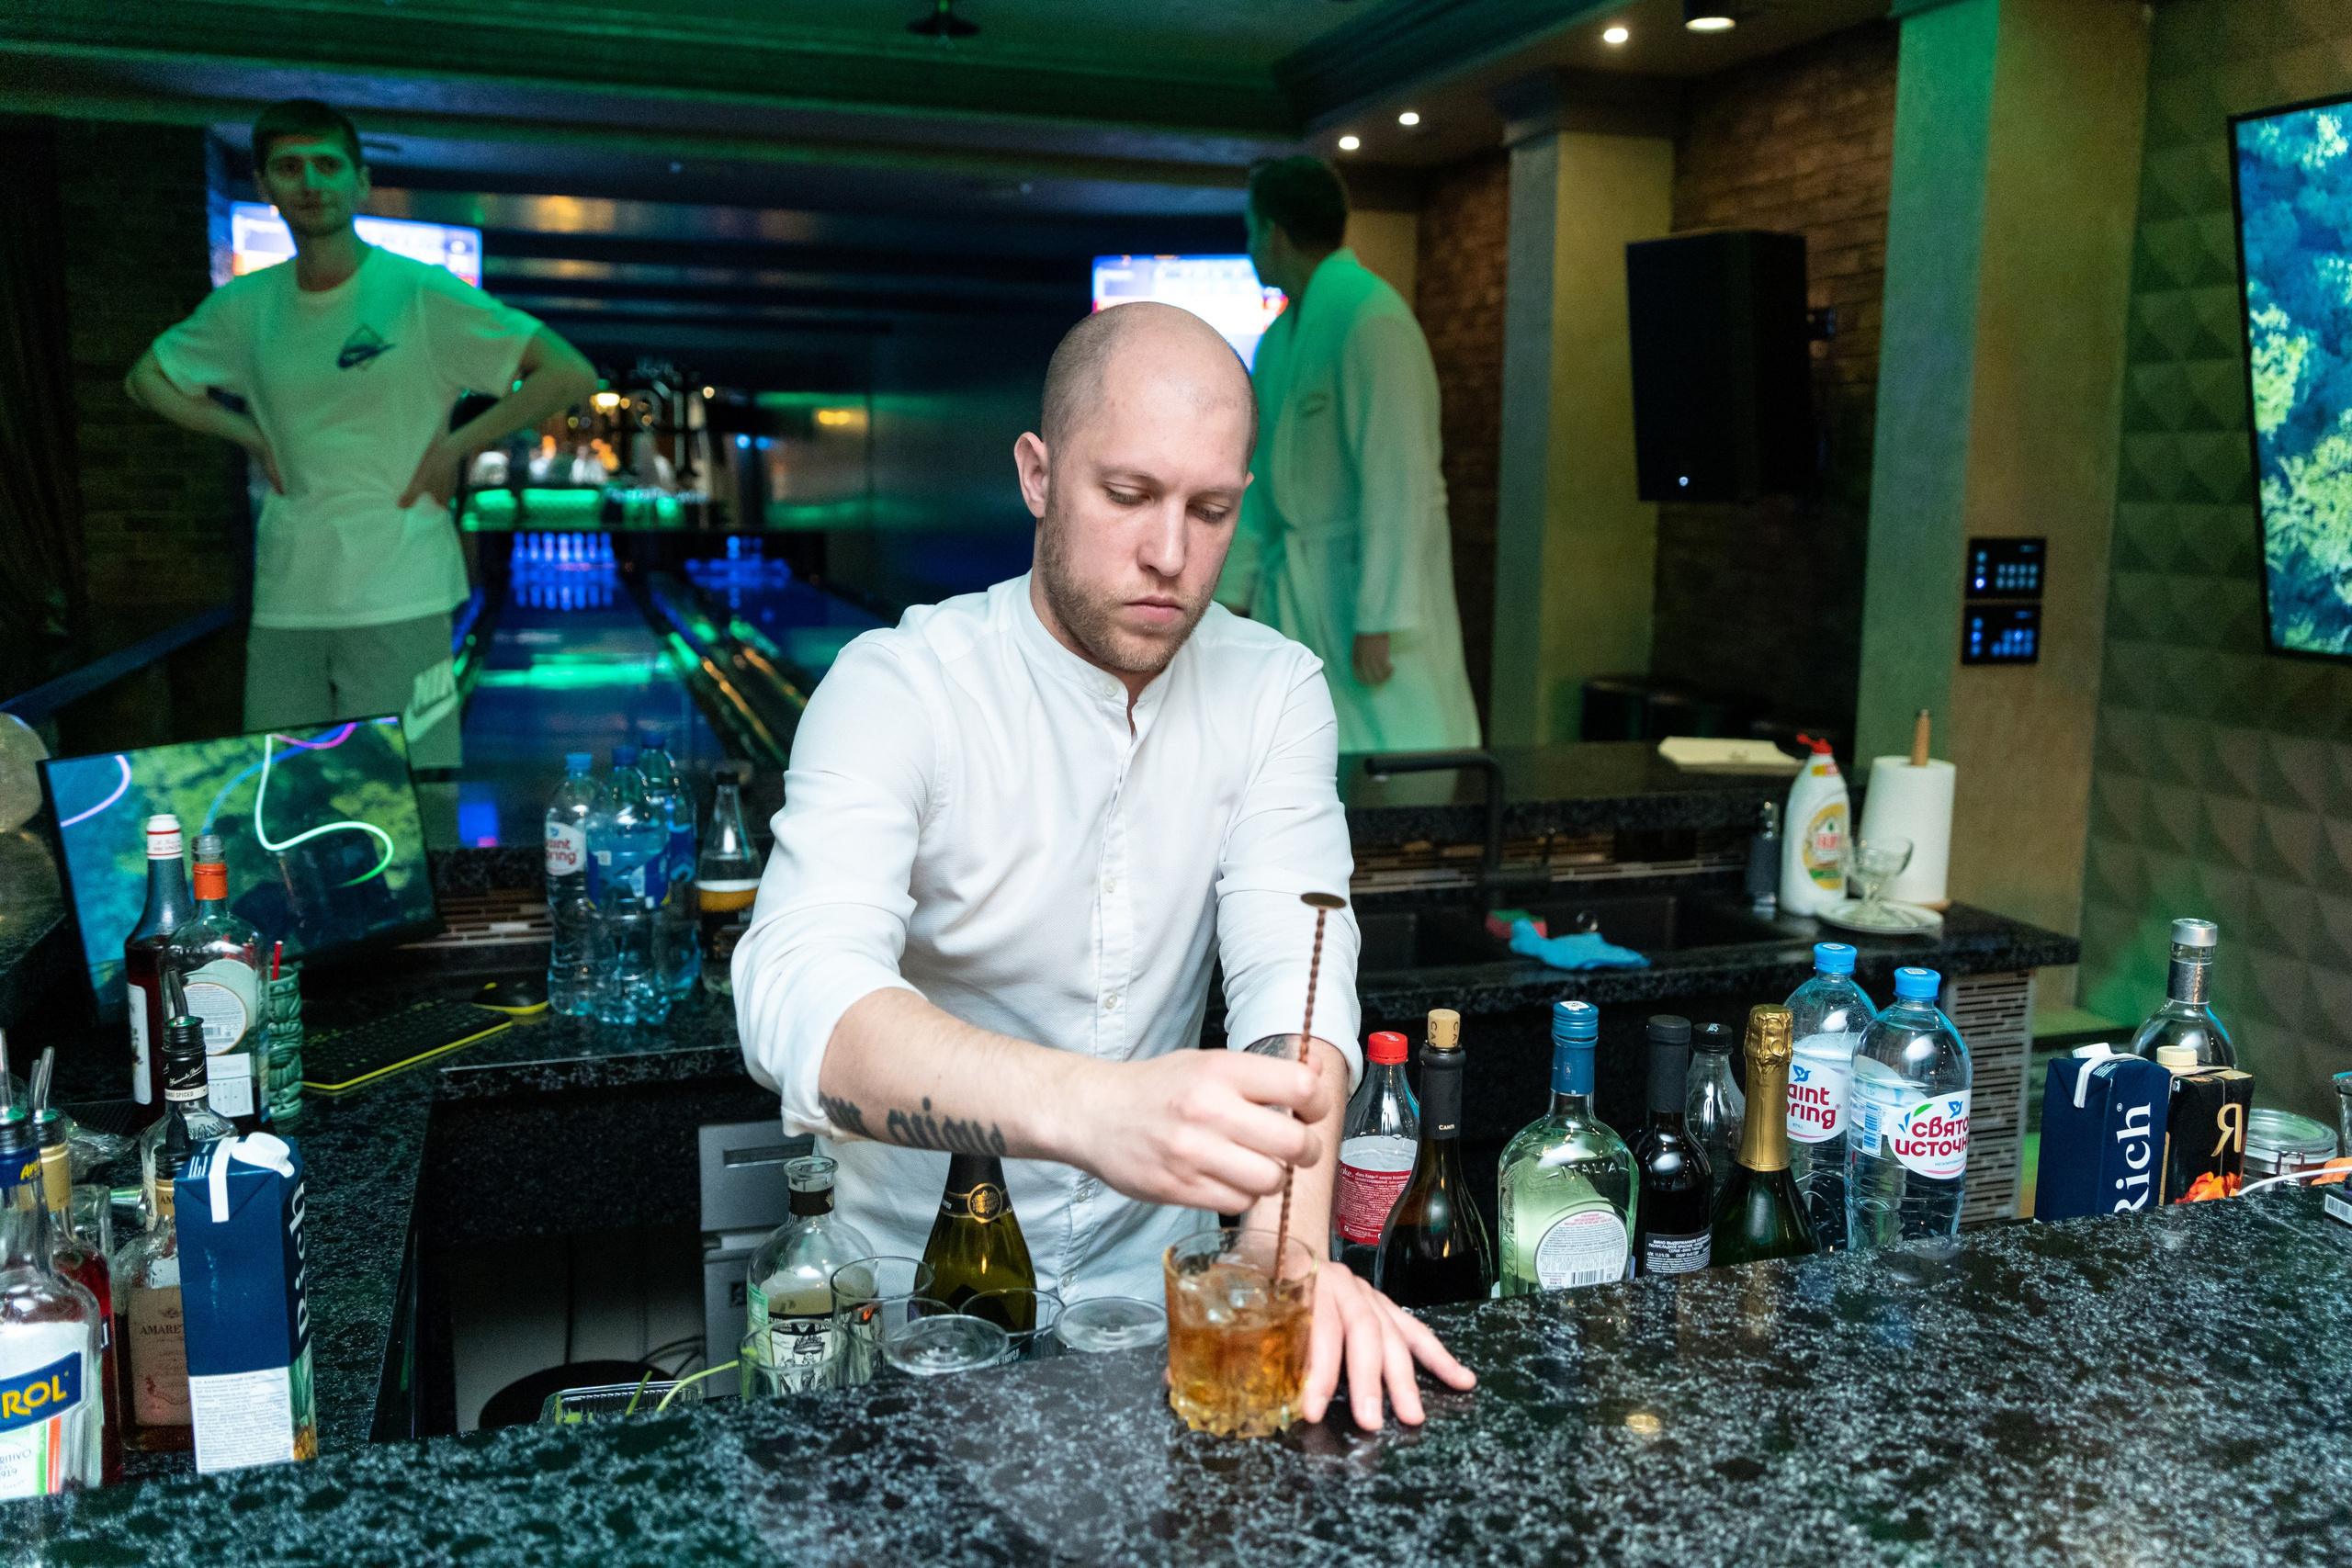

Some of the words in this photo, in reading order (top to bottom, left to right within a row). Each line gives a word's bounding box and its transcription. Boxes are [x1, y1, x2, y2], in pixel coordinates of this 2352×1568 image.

[547, 837, 571, 850] aint
[1787, 1083, 1830, 1106] aint
[1786, 1102, 1837, 1130] ring
[2211, 1102, 2243, 1153] Я
[2113, 1101, 2151, 1213] Rich
[1562, 1161, 1617, 1179] ITALIA
[140, 1323, 183, 1335] AMARE
[2, 1374, 67, 1418] ROL
[0, 1449, 32, 1465] RITIVO
[0, 1468, 17, 1478] 919
